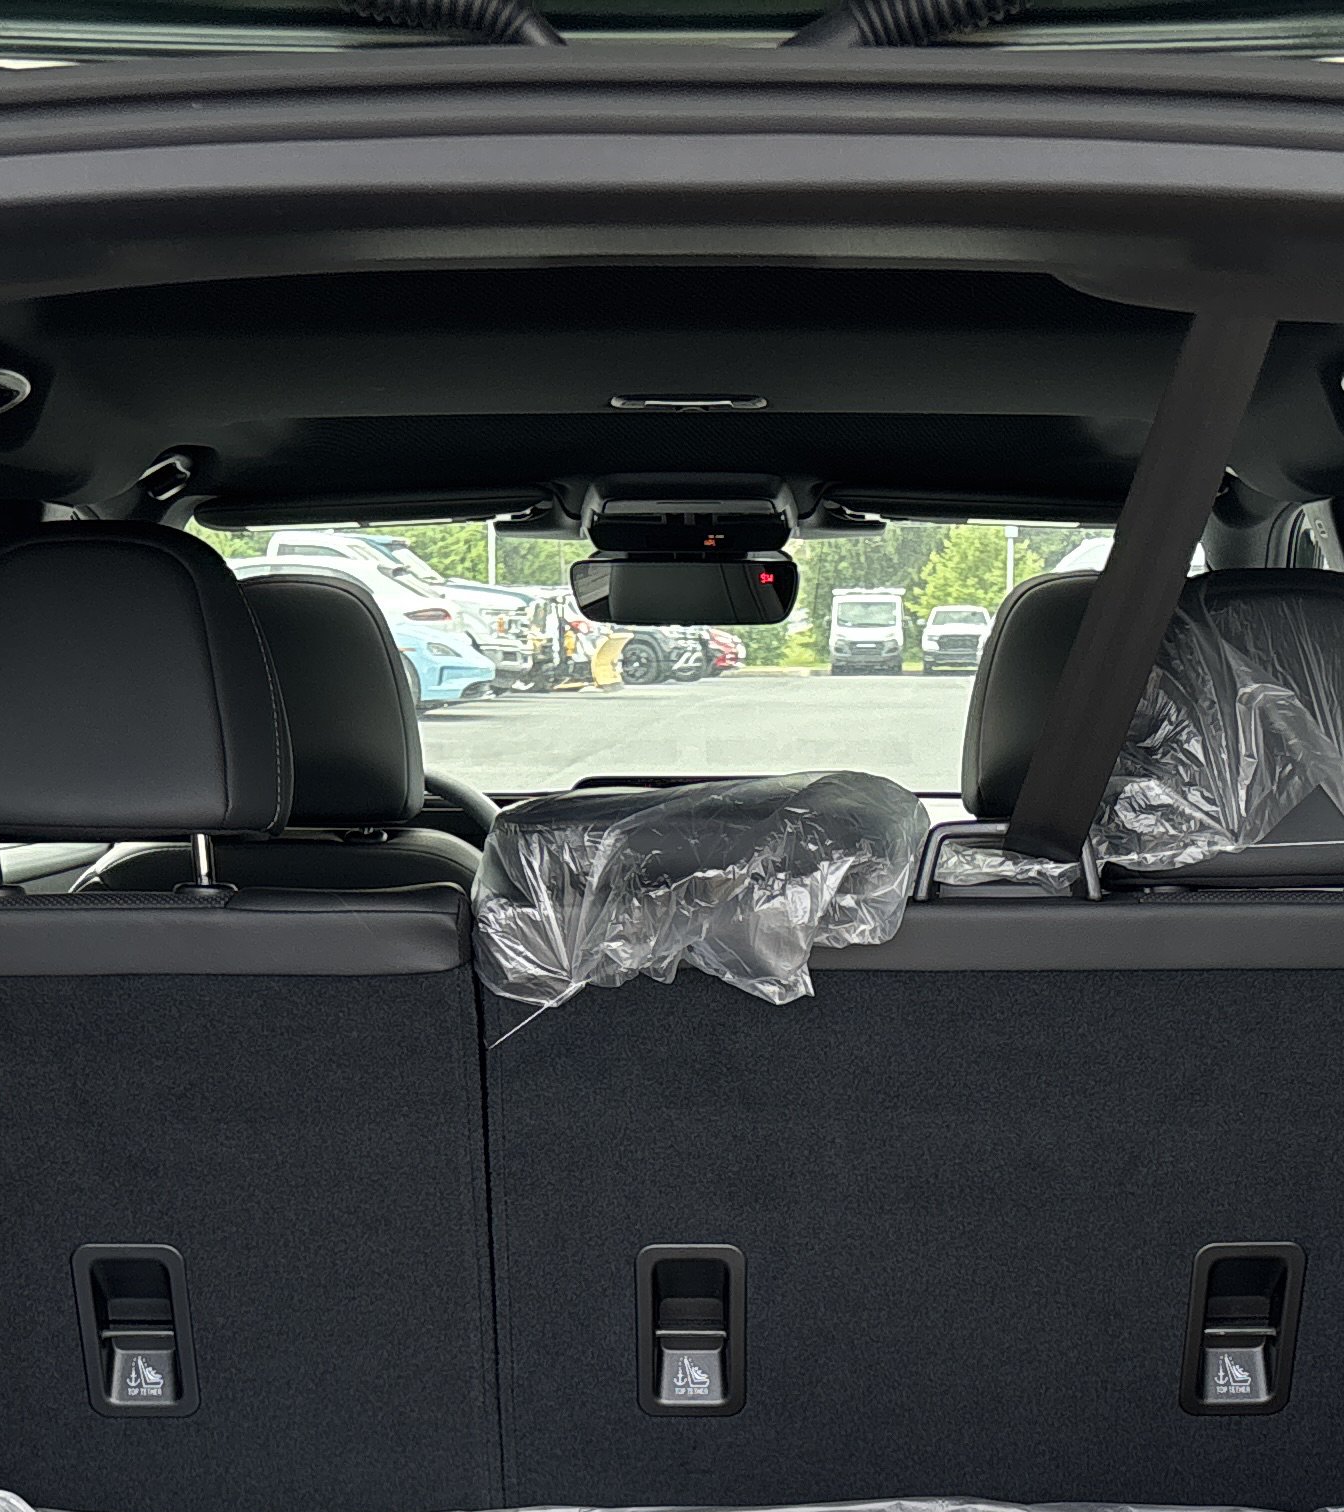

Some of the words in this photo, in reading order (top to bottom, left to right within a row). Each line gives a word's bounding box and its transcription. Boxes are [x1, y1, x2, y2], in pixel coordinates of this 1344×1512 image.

[128, 1387, 139, 1396] TOP
[675, 1387, 686, 1395] TOP
[1216, 1385, 1227, 1394] TOP
